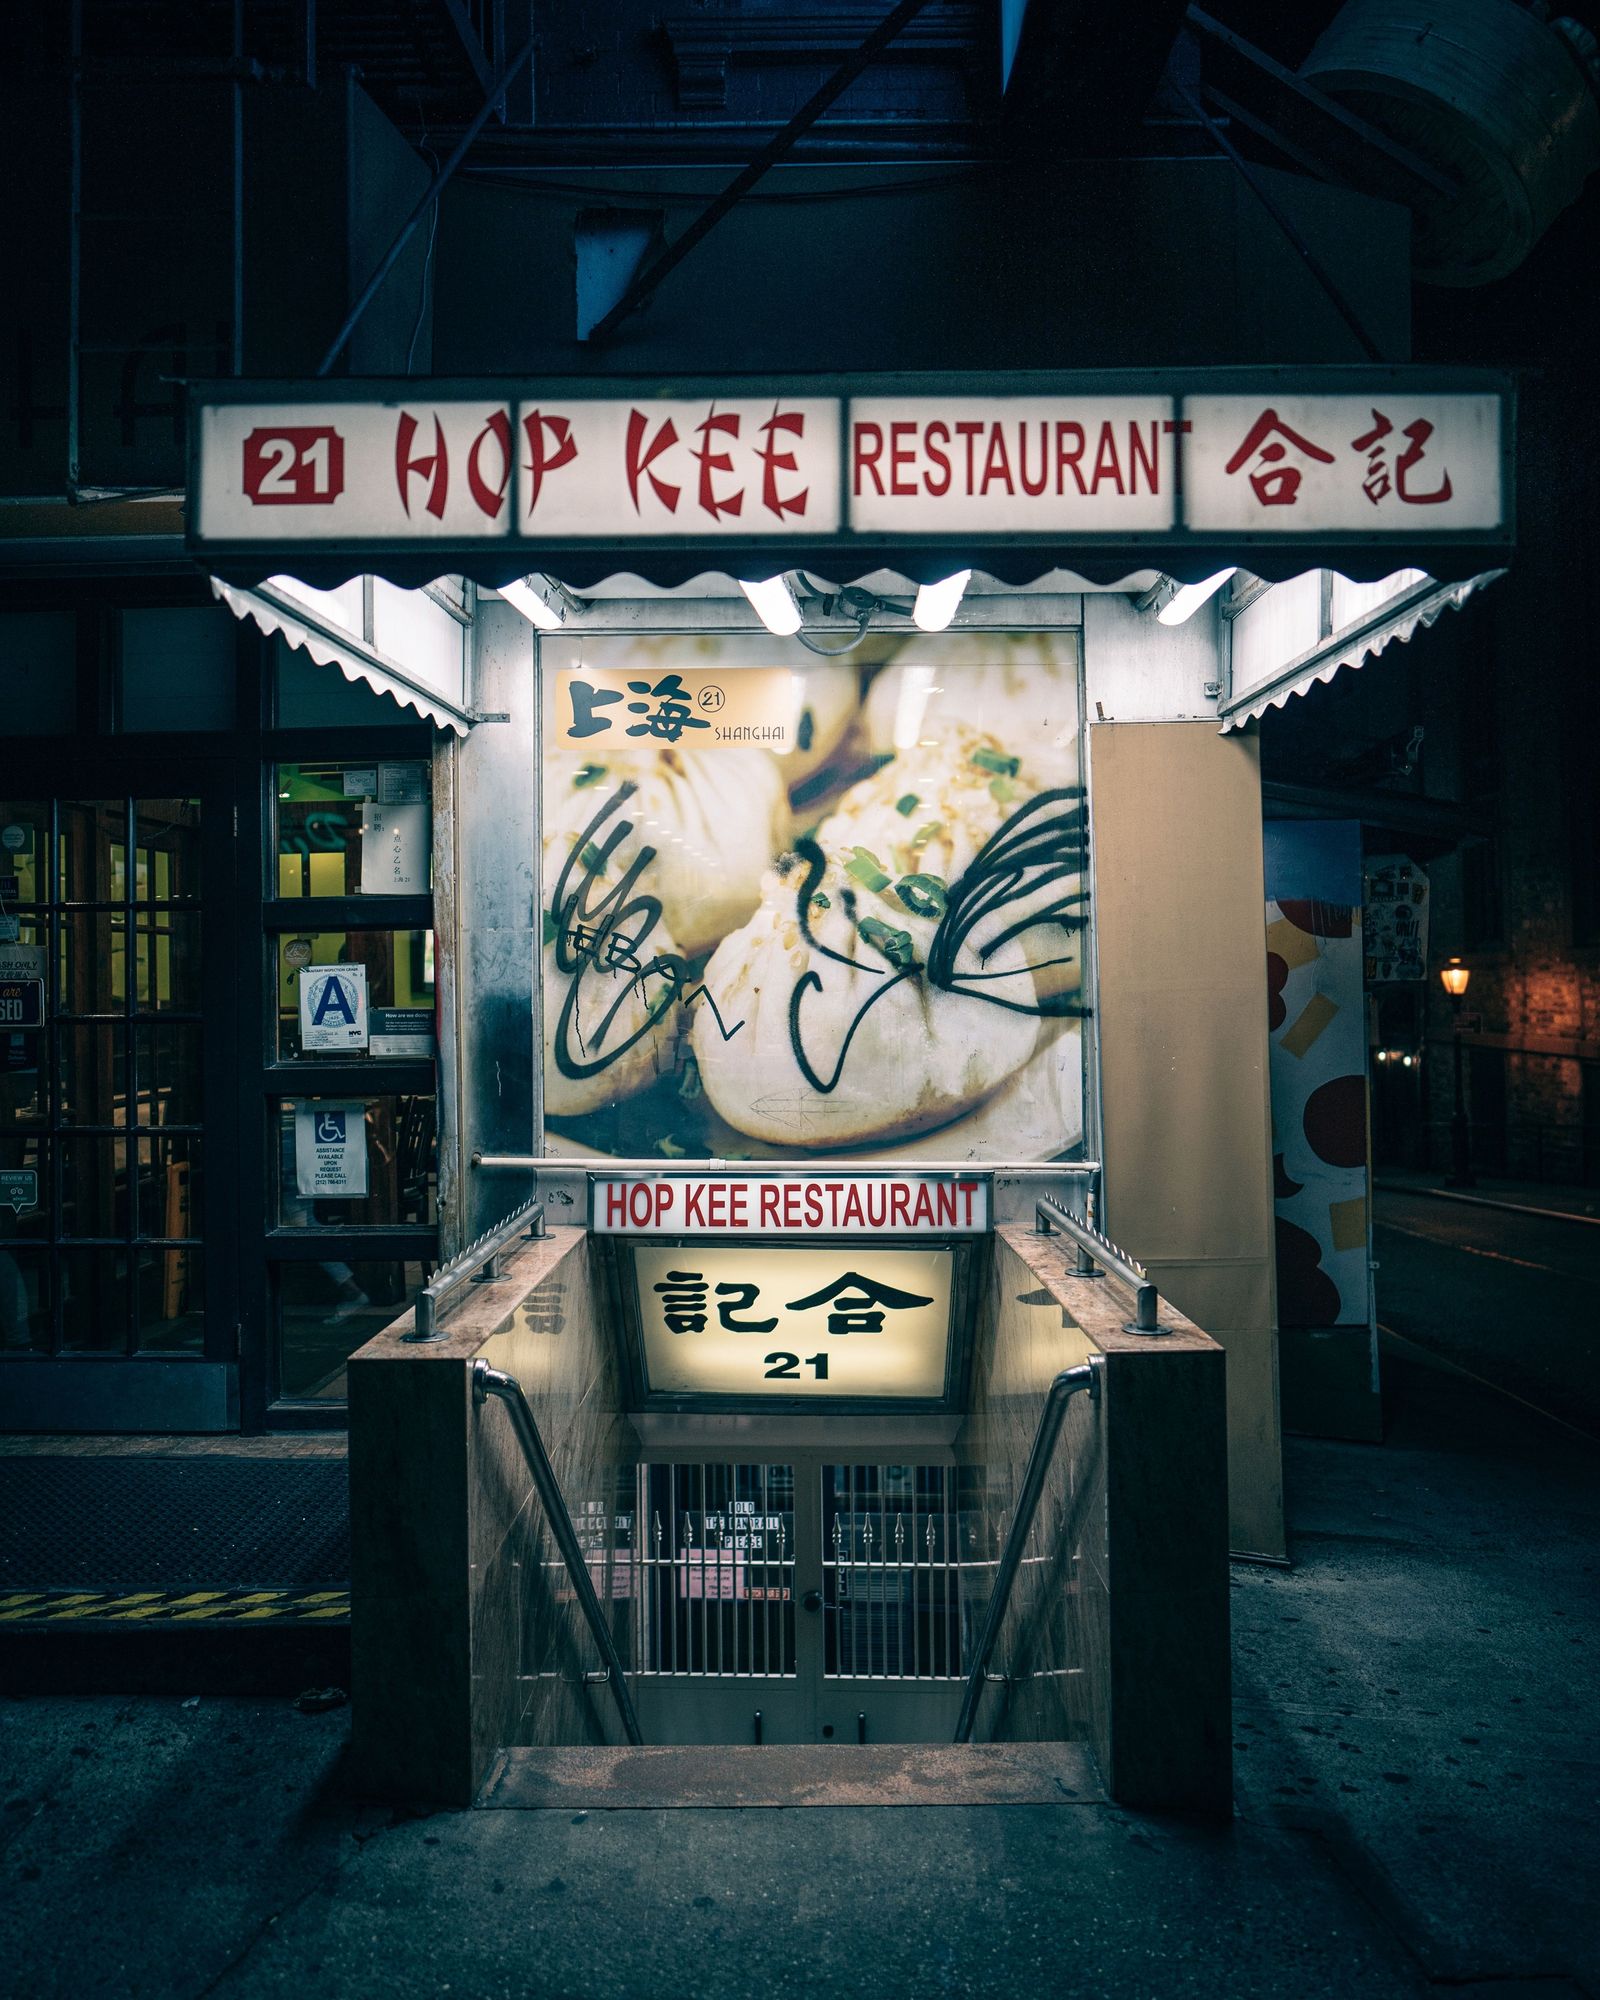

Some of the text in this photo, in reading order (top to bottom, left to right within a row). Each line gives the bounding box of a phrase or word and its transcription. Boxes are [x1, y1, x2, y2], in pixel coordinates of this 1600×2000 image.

[258, 400, 1193, 522] 21 HOP KEE RESTAURANT
[1224, 406, 1454, 507] 合記
[566, 674, 712, 743] 上海
[714, 725, 785, 741] SHANGHAI
[15, 960, 38, 970] ONLY
[312, 975, 356, 1026] A
[606, 1183, 979, 1228] HOP KEE RESTAURANT
[763, 1352, 830, 1380] 21
